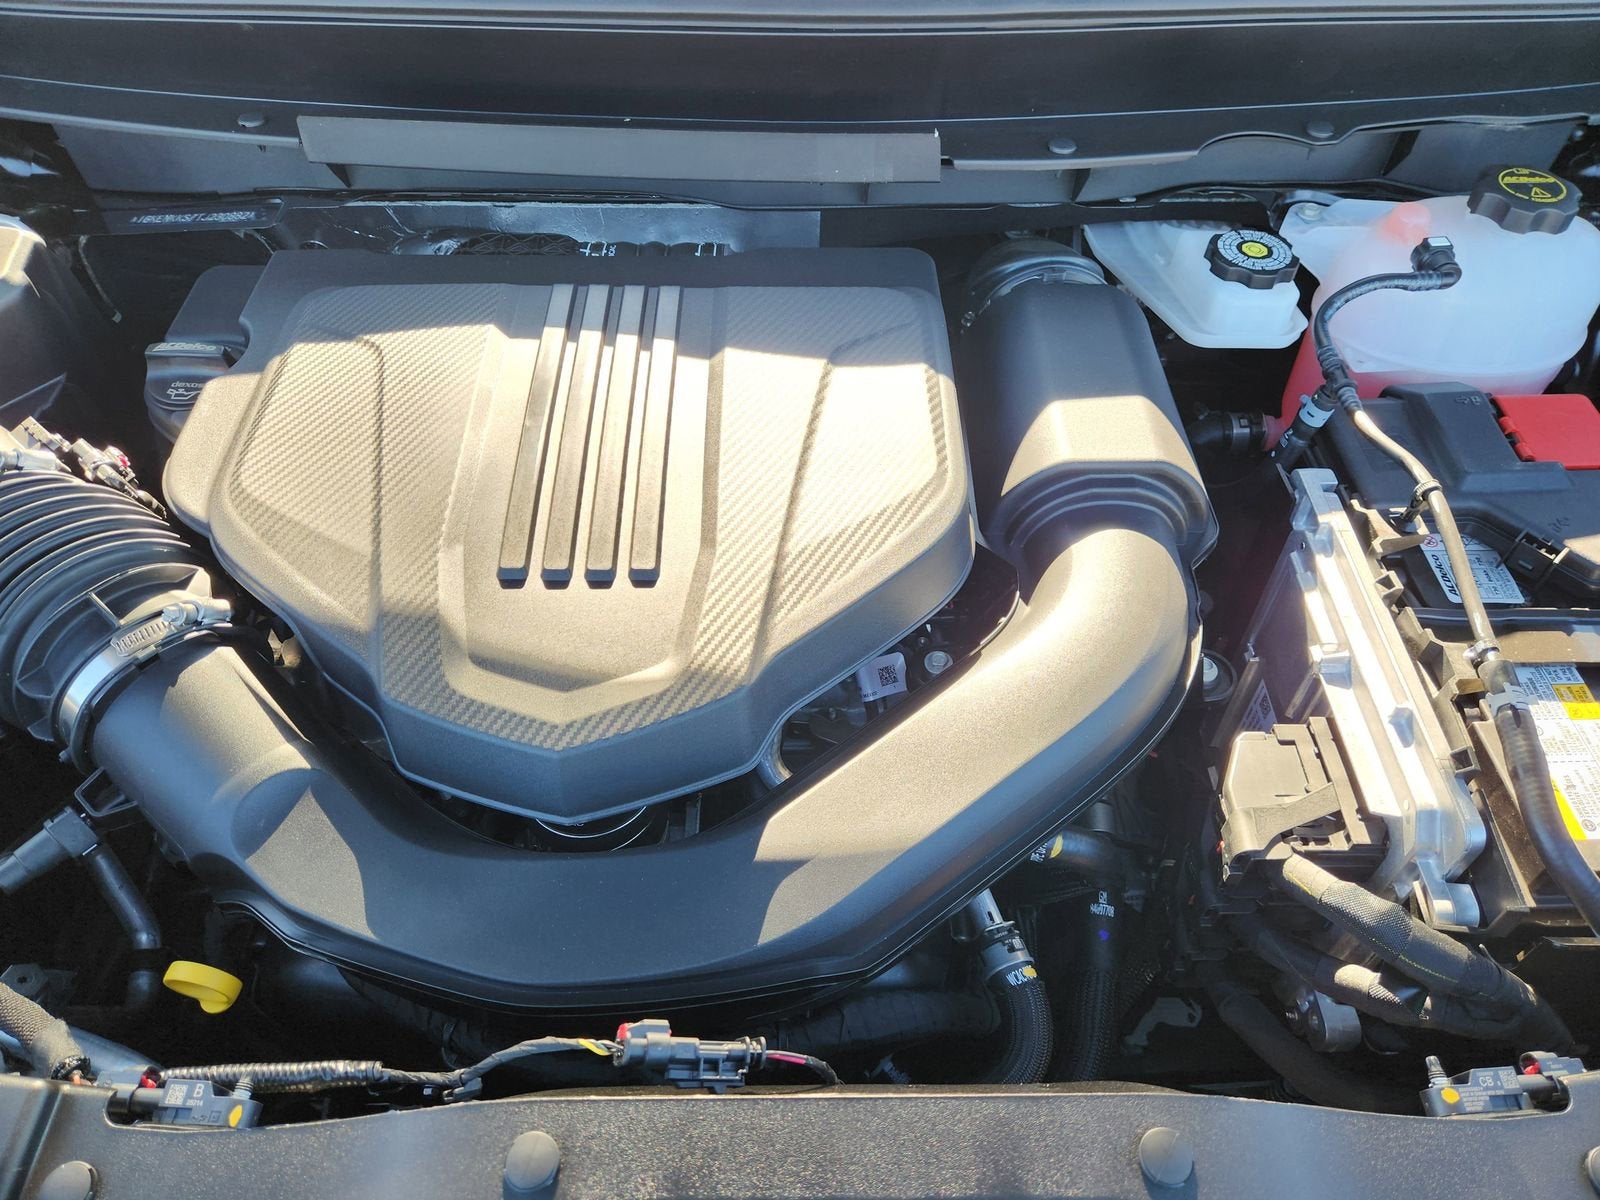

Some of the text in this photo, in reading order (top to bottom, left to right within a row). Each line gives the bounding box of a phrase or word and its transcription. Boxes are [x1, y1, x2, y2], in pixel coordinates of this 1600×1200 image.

[152, 342, 217, 352] ACDelco
[1431, 554, 1459, 597] ACDelco
[1479, 1076, 1494, 1087] CB
[193, 1083, 205, 1098] B
